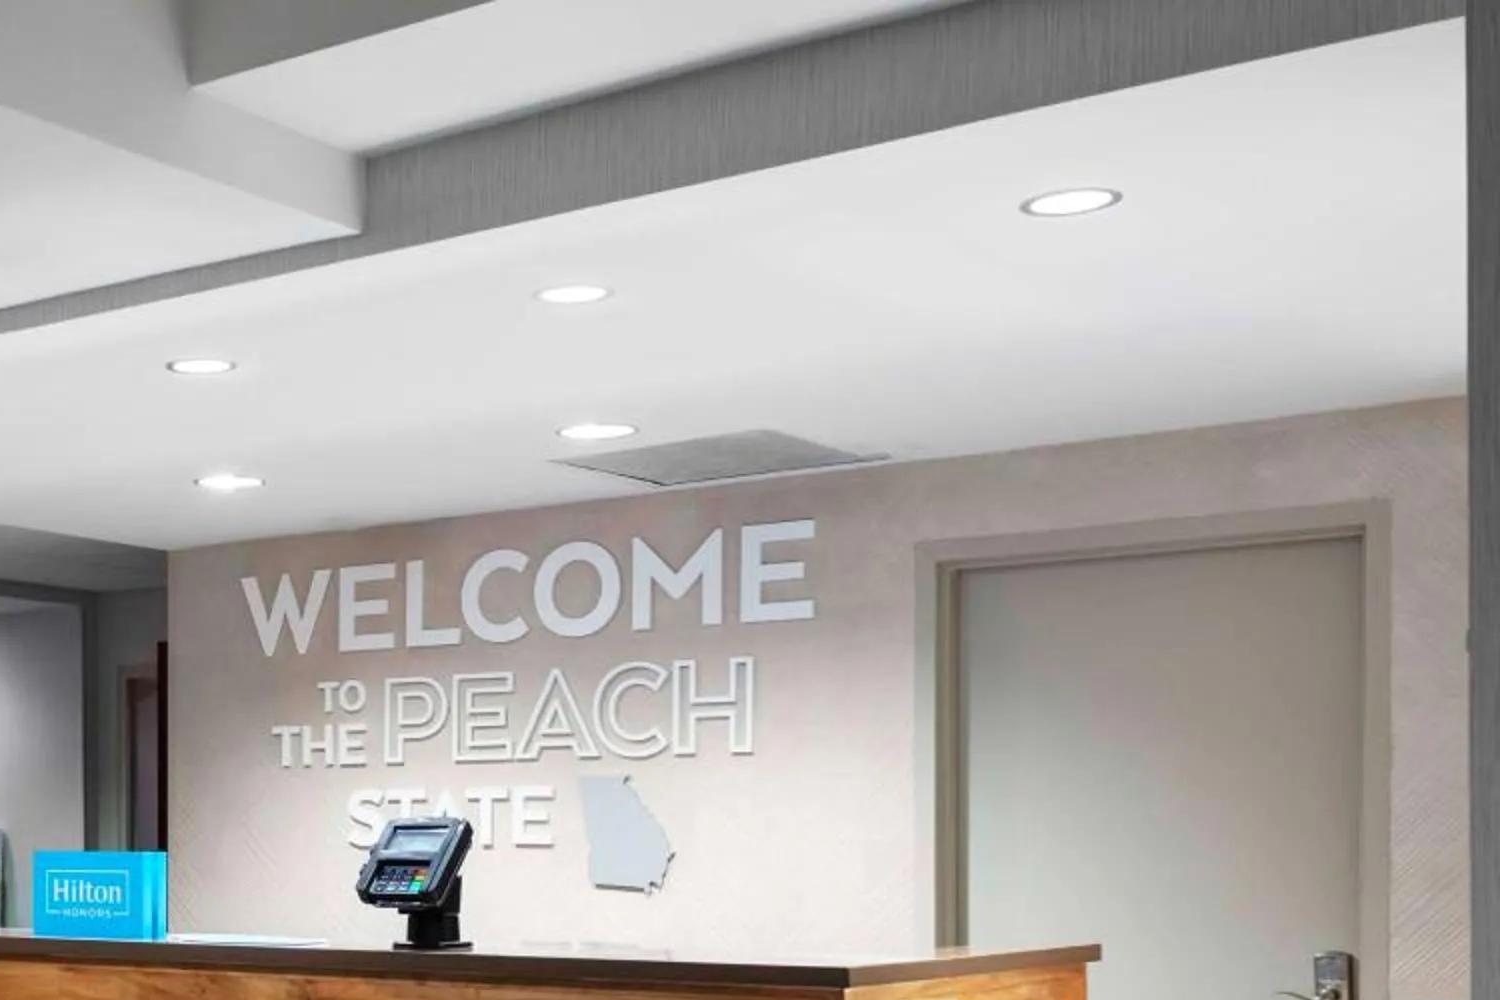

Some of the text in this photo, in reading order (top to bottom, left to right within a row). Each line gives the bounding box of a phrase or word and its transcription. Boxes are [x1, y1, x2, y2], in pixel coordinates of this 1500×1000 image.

[241, 519, 816, 658] WELCOME
[272, 656, 755, 768] THE PEACH
[317, 679, 366, 714] TO
[53, 879, 122, 904] Hilton
[62, 907, 112, 919] HONORS
